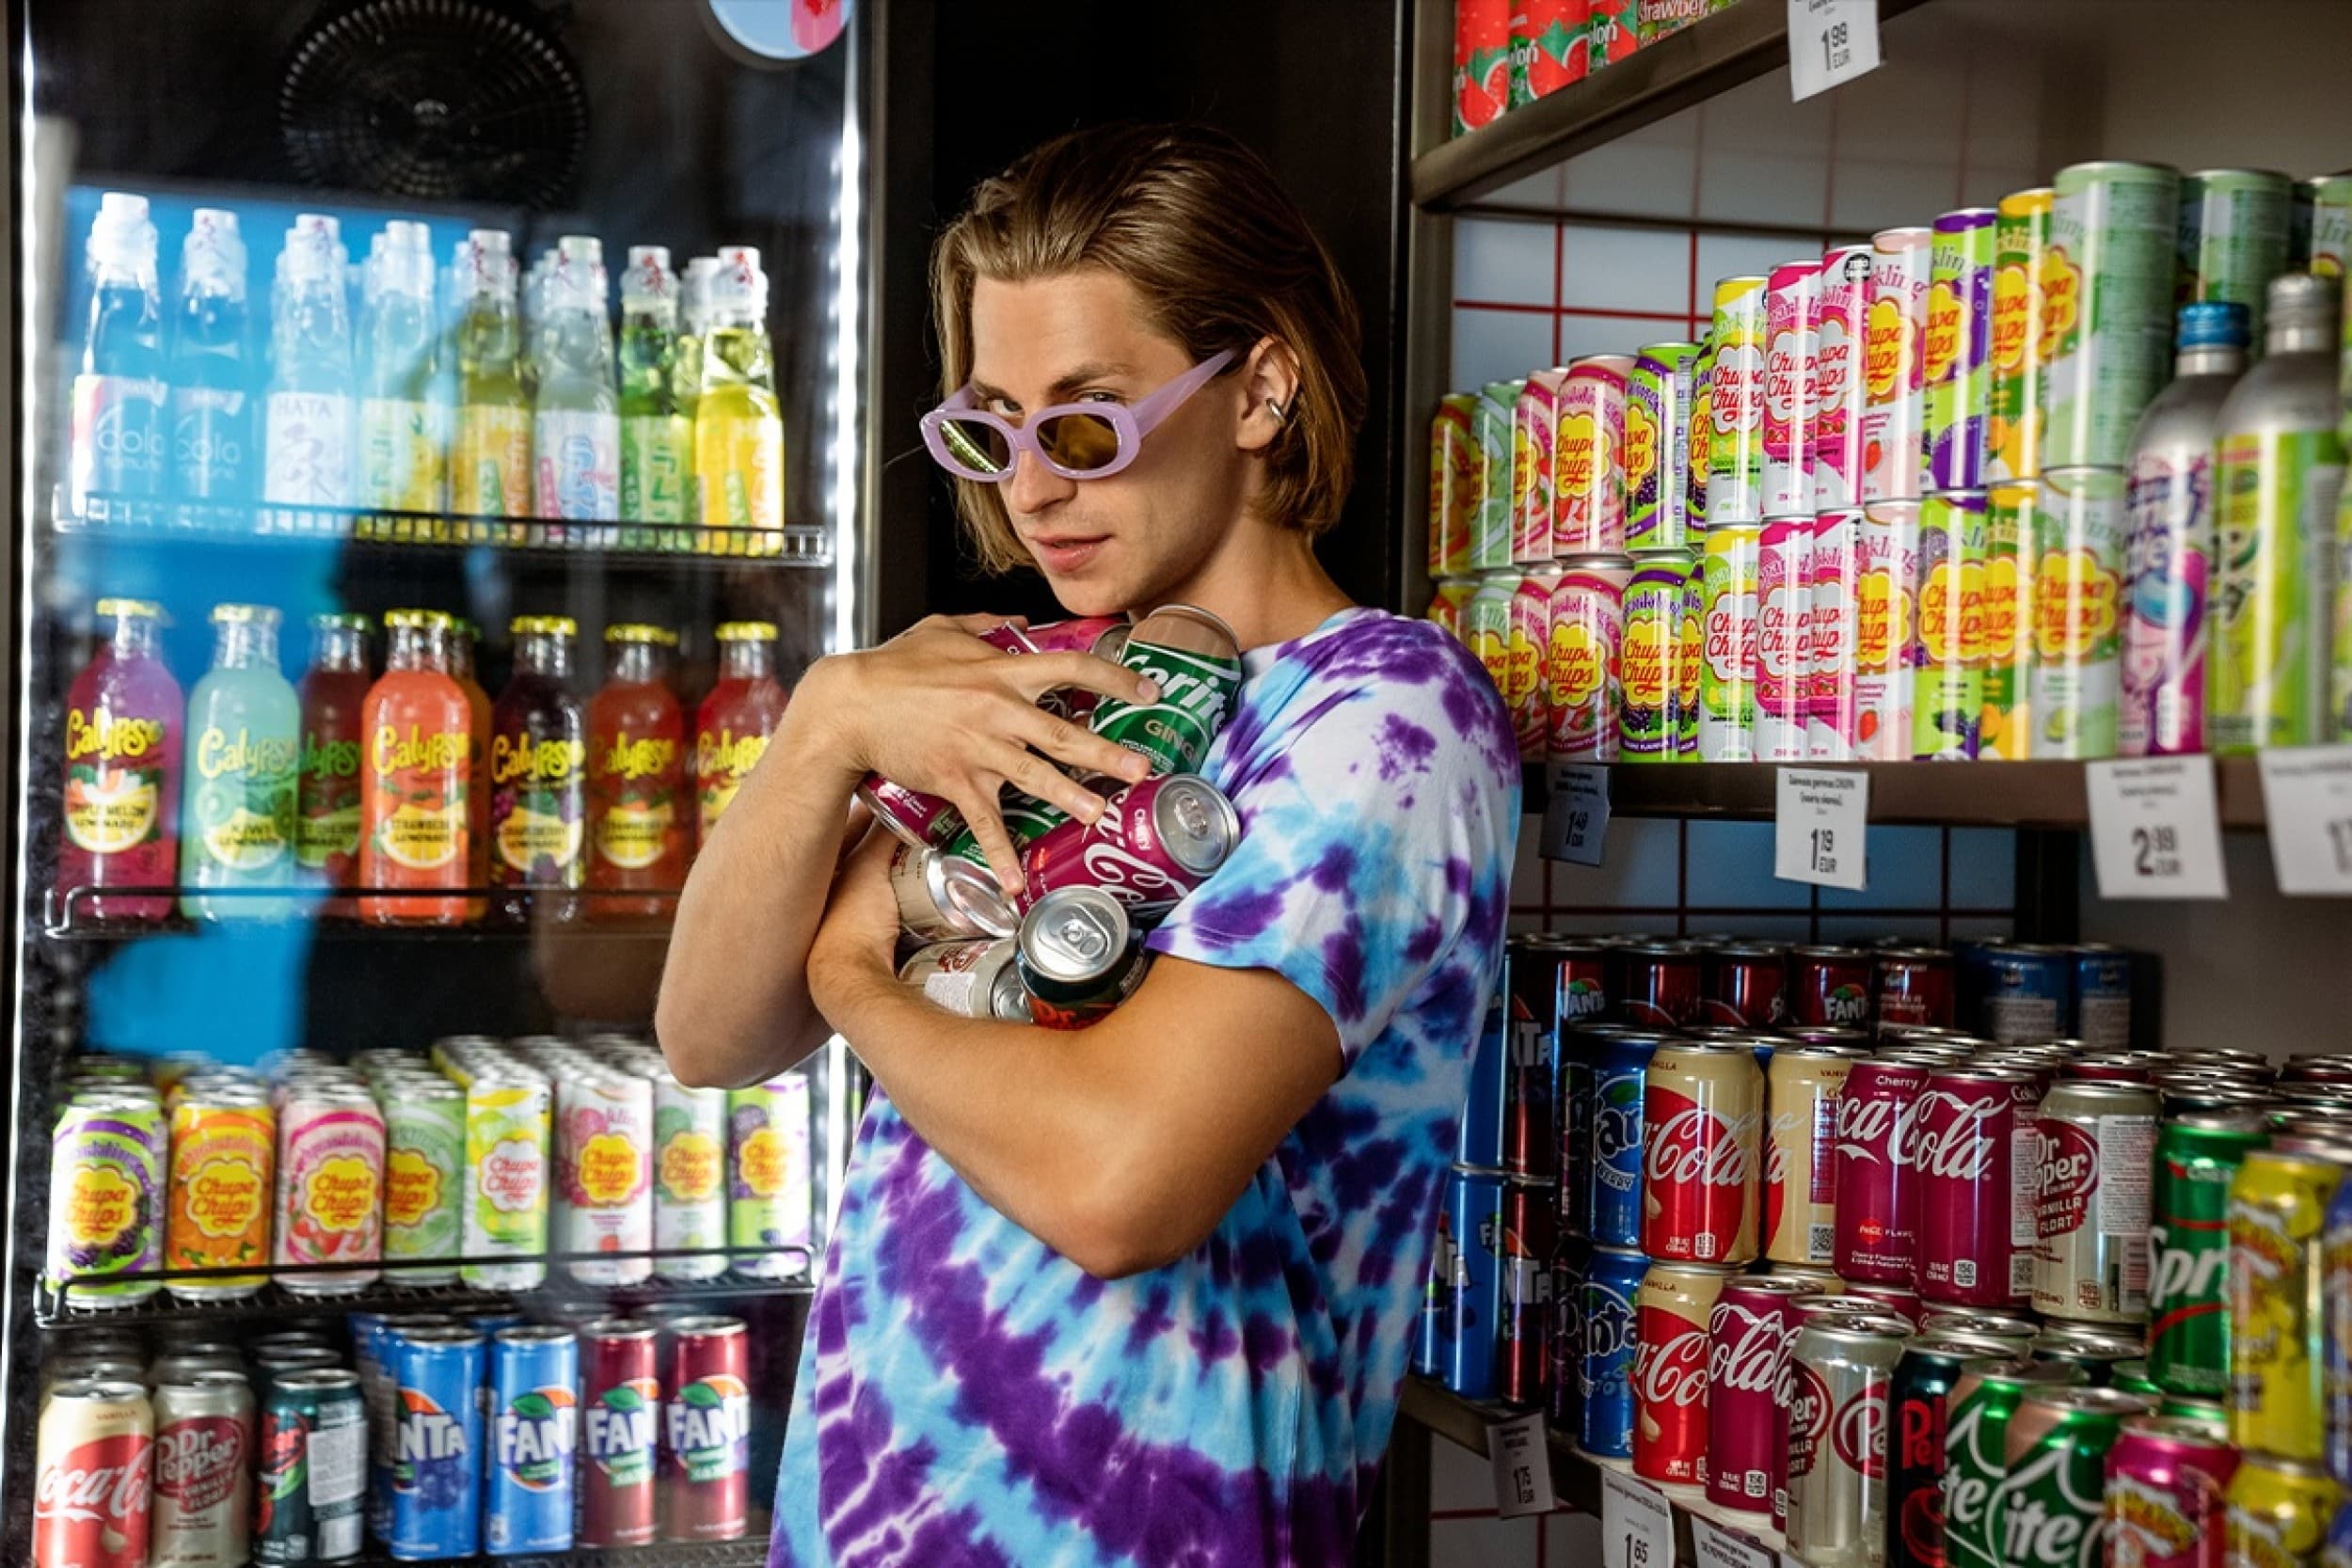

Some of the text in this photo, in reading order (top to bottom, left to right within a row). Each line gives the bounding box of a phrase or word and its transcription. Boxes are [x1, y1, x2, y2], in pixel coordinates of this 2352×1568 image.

[1144, 719, 1196, 759] GING
[1875, 1074, 1919, 1090] Cherry
[178, 1428, 216, 1455] Dr
